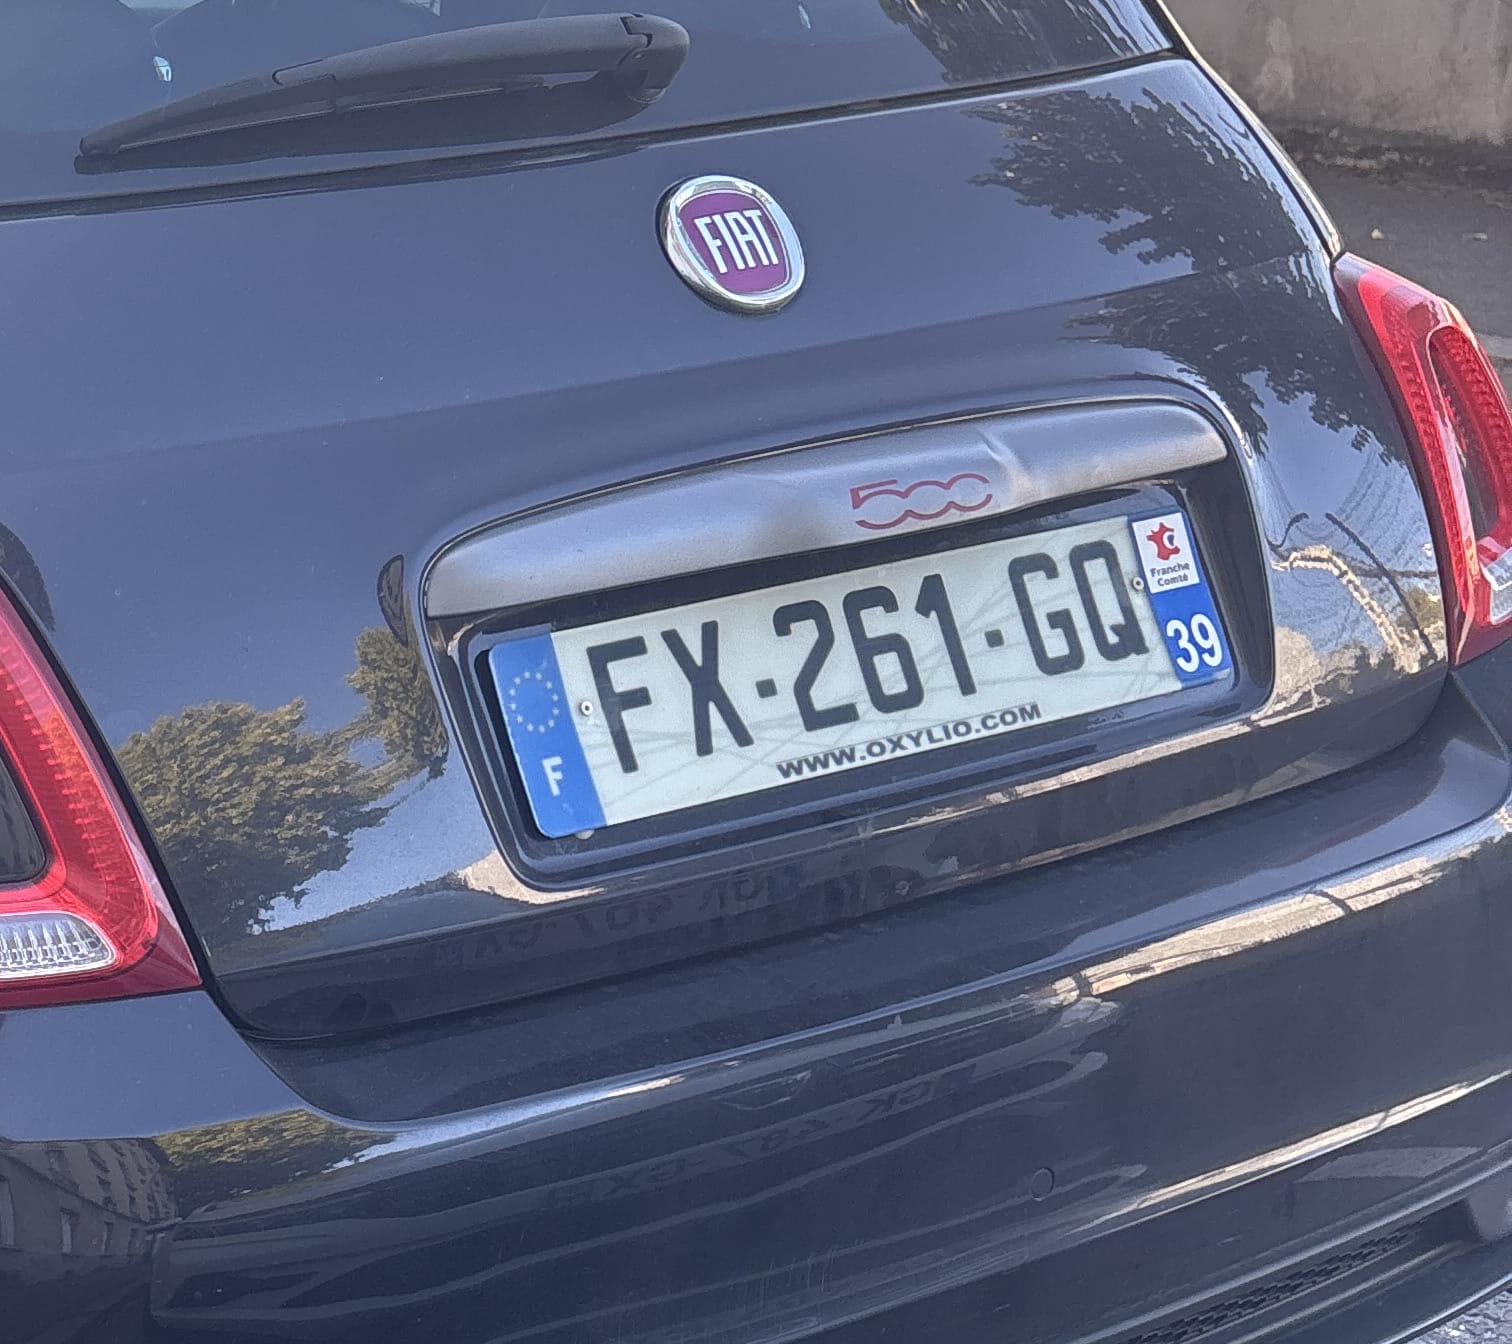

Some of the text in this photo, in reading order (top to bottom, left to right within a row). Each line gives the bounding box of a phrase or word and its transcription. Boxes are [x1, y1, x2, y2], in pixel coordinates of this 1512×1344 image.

[693, 209, 780, 274] FIAT
[849, 472, 994, 531] 500
[1150, 561, 1191, 579] Franche
[1157, 572, 1190, 587] Comté
[1165, 612, 1224, 674] 39
[775, 702, 1043, 780] WWW.OXYLIO.COM
[541, 755, 565, 797] F
